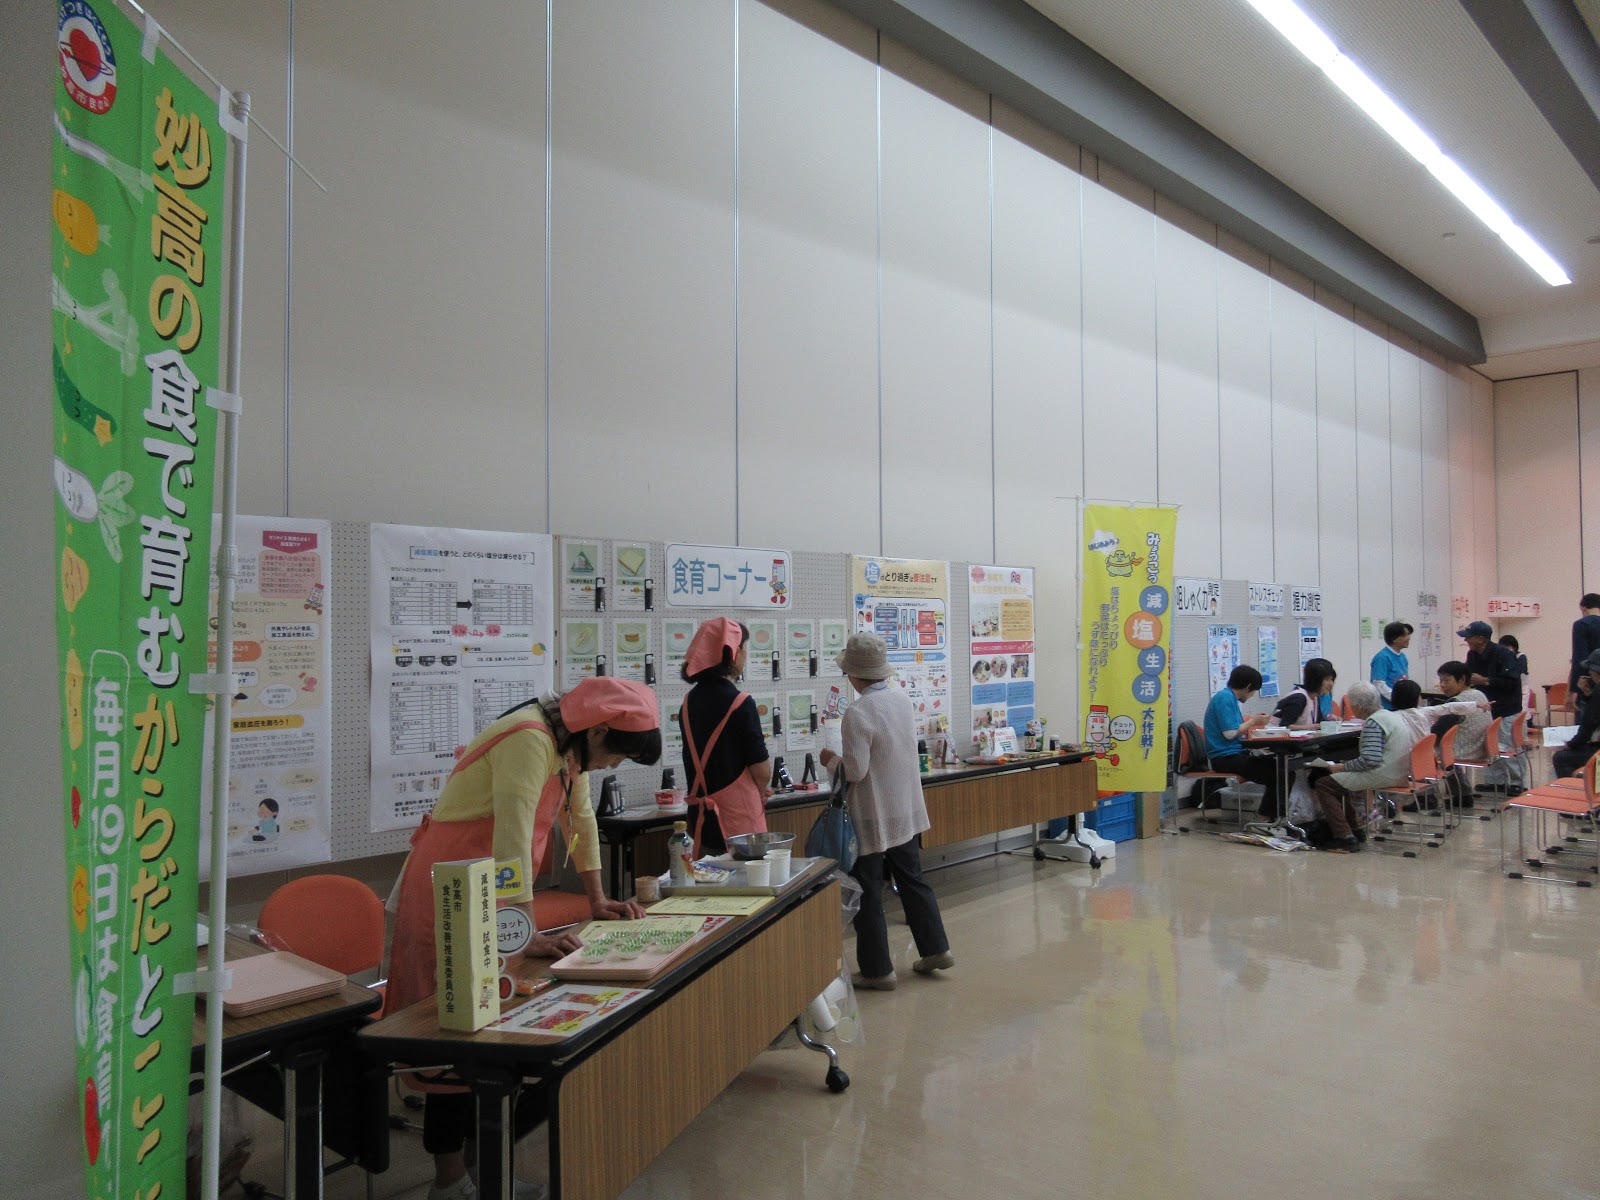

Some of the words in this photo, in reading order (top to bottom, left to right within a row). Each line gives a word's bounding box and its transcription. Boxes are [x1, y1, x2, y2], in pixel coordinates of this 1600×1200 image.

[672, 557, 767, 595] 食育コーナー
[1249, 587, 1284, 603] ストレスチェック
[1292, 591, 1321, 612] 握力測定
[1488, 600, 1531, 613] 歯科コーナー
[453, 878, 462, 912] 妙高市
[442, 884, 455, 1014] 食生活改善推進委員の会
